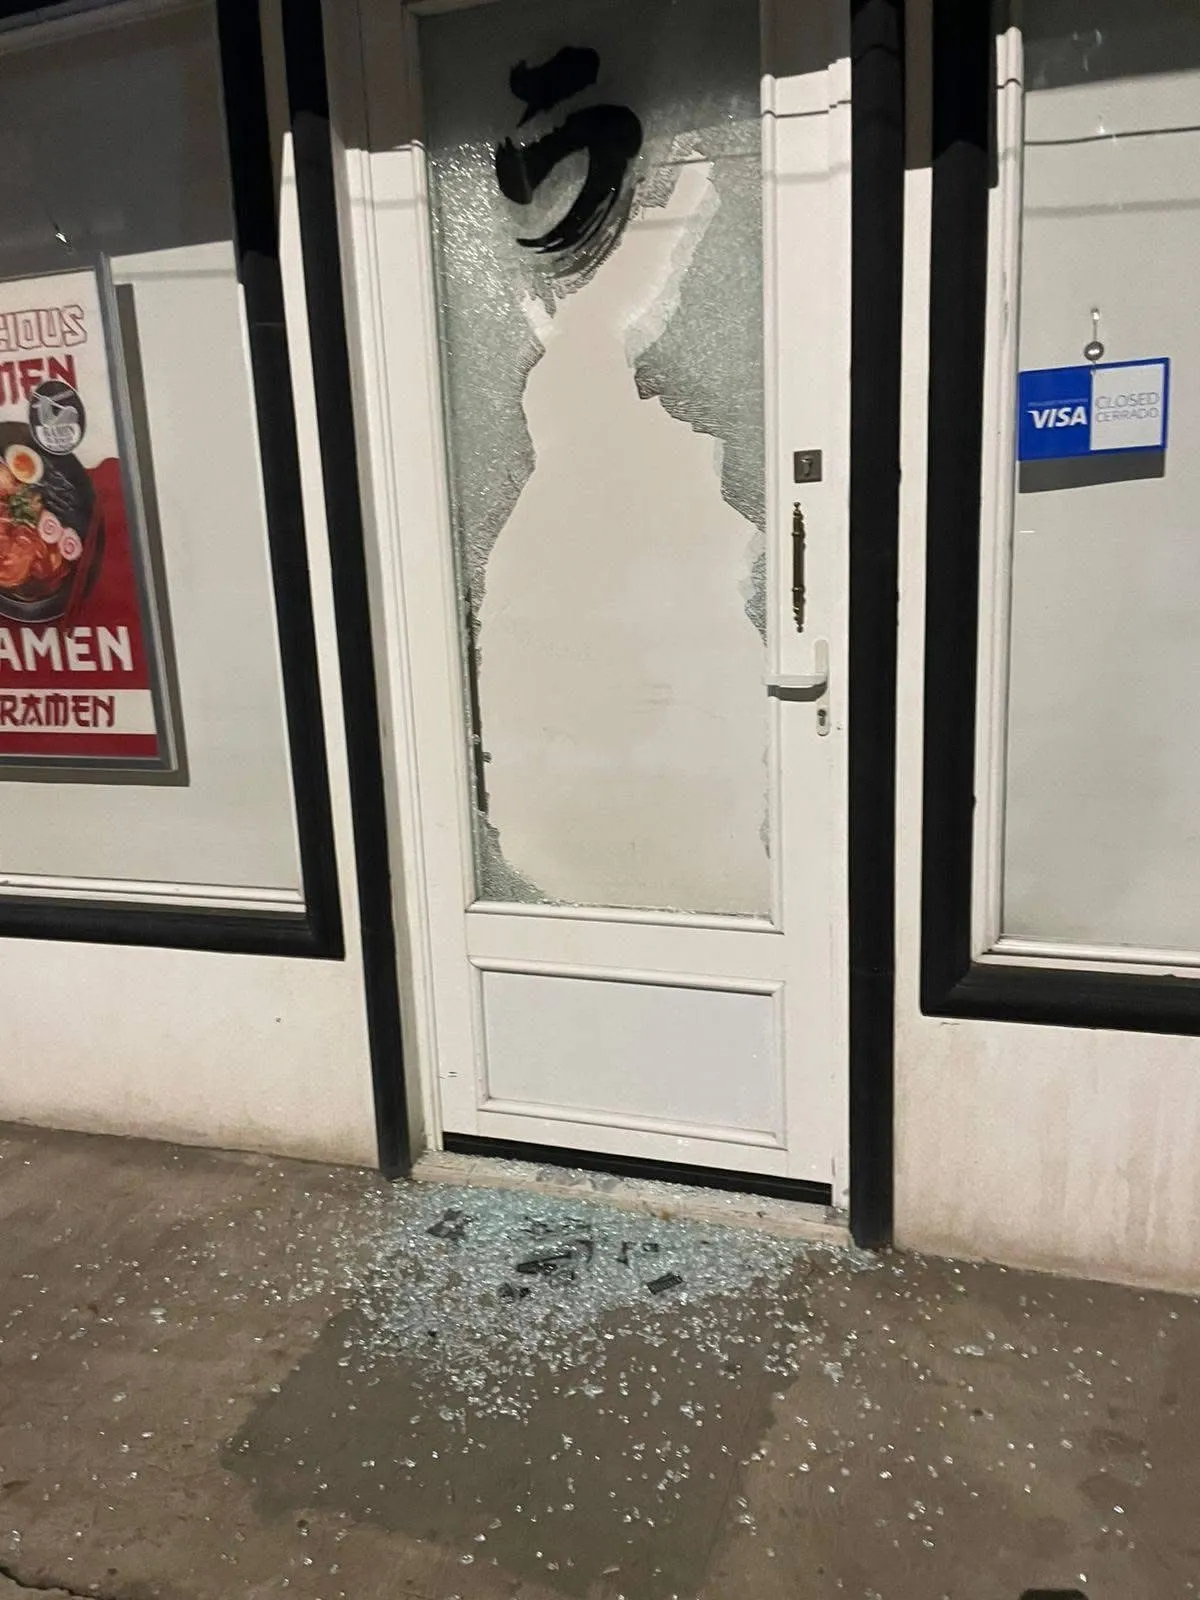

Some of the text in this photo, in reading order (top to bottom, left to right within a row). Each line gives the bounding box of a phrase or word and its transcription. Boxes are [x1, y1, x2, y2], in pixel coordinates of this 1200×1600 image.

[1095, 391, 1160, 409] CLOSED
[1028, 406, 1088, 429] VISA
[1095, 407, 1160, 422] CERRADO
[0, 693, 115, 727] RAMEN
